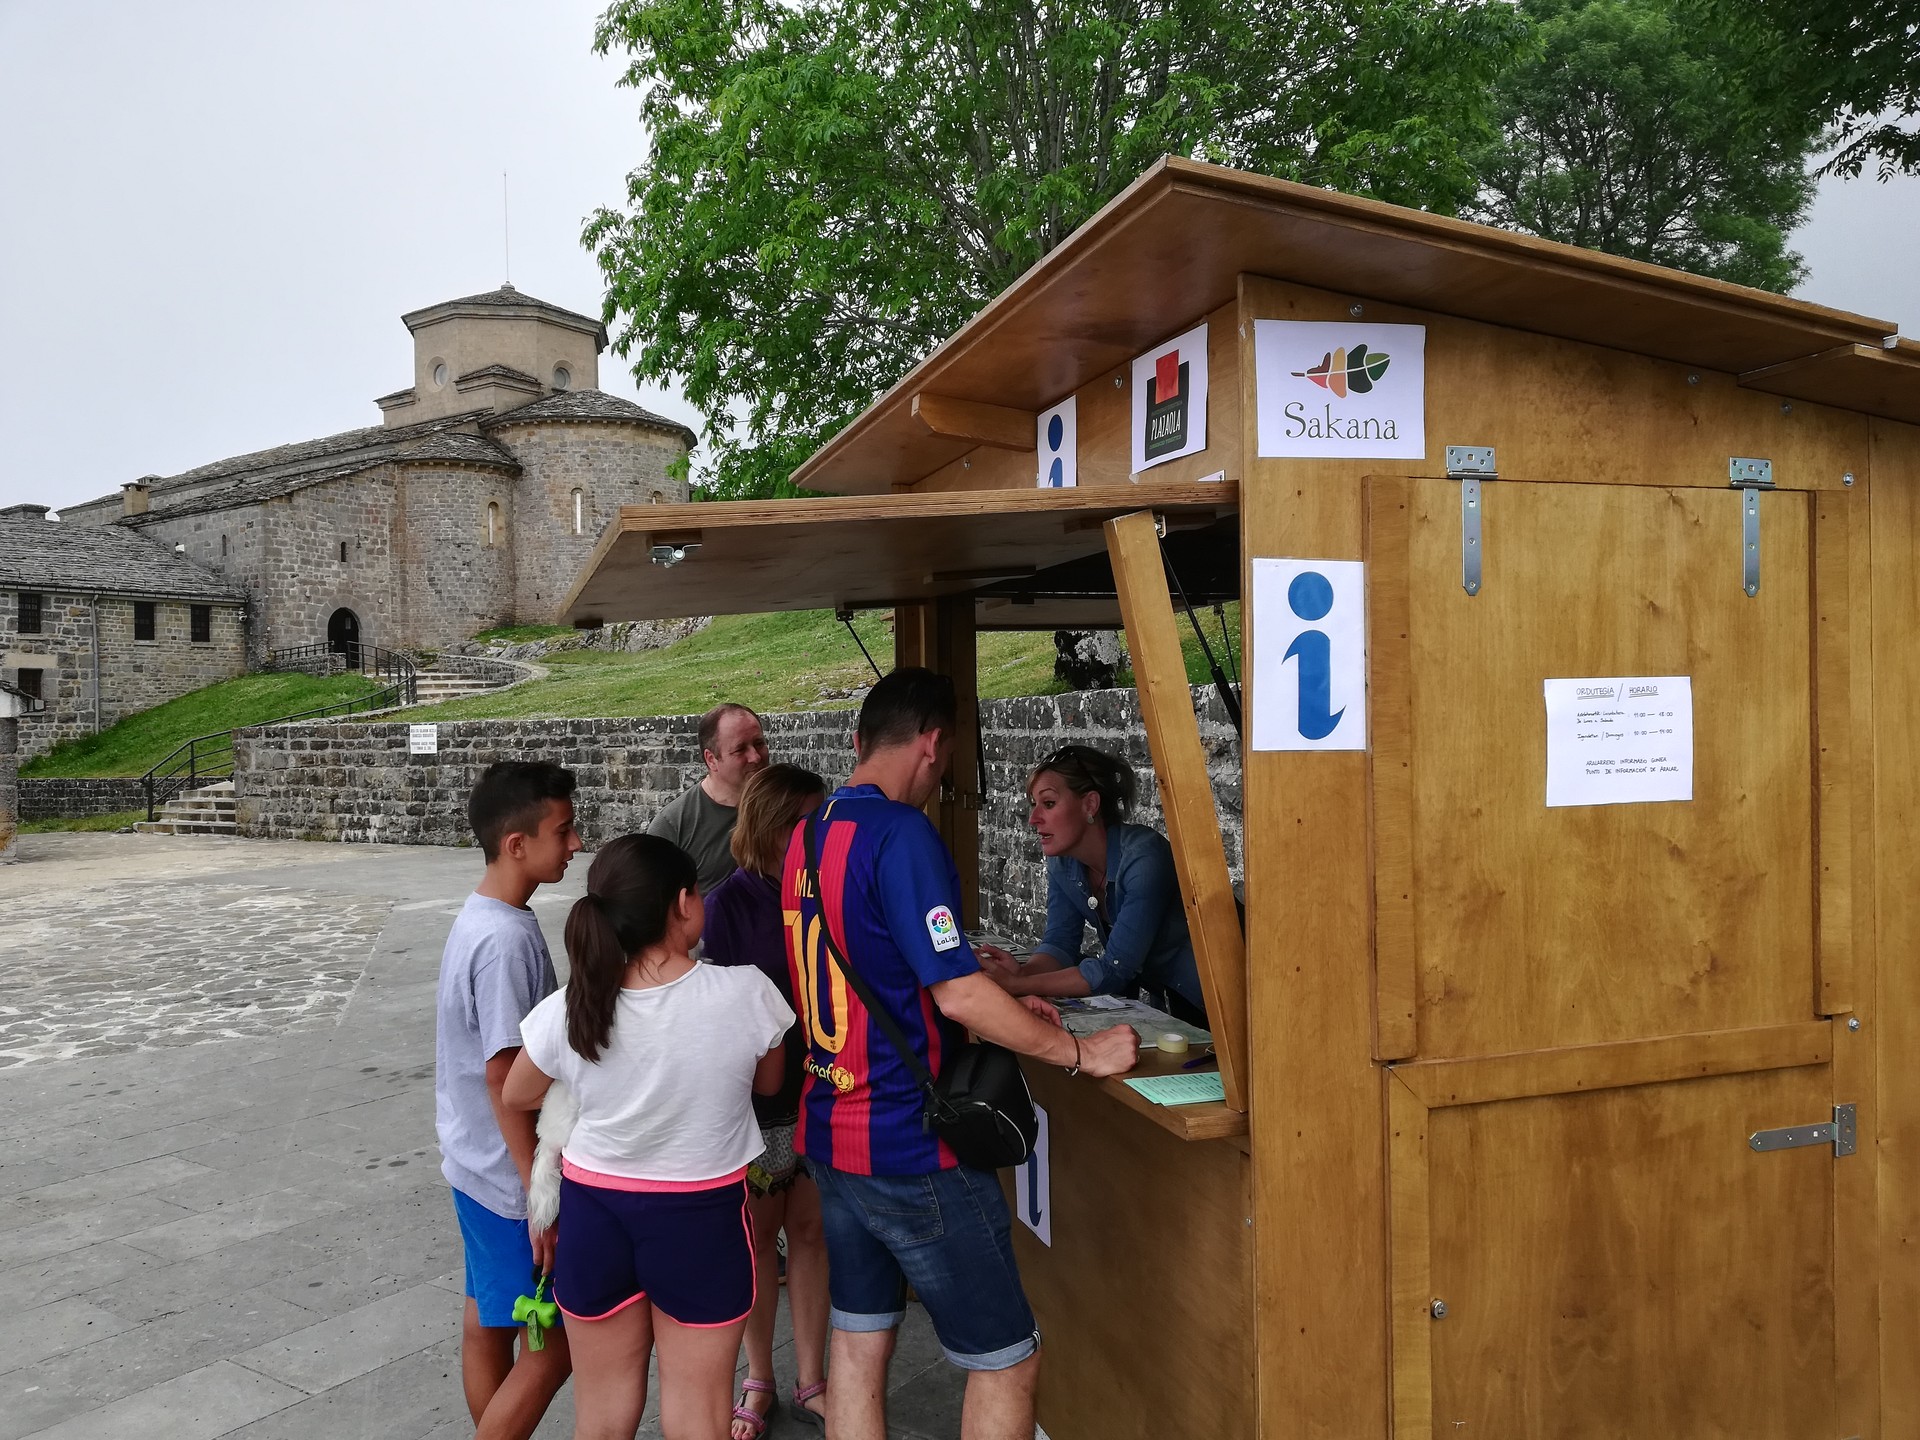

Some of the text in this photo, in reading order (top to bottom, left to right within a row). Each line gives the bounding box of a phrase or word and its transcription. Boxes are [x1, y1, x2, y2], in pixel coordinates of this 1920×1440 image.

[1150, 409, 1181, 441] PLAZAOLA
[1284, 401, 1399, 440] Sakana
[1629, 685, 1658, 694] HORARIO
[783, 910, 848, 1054] 10
